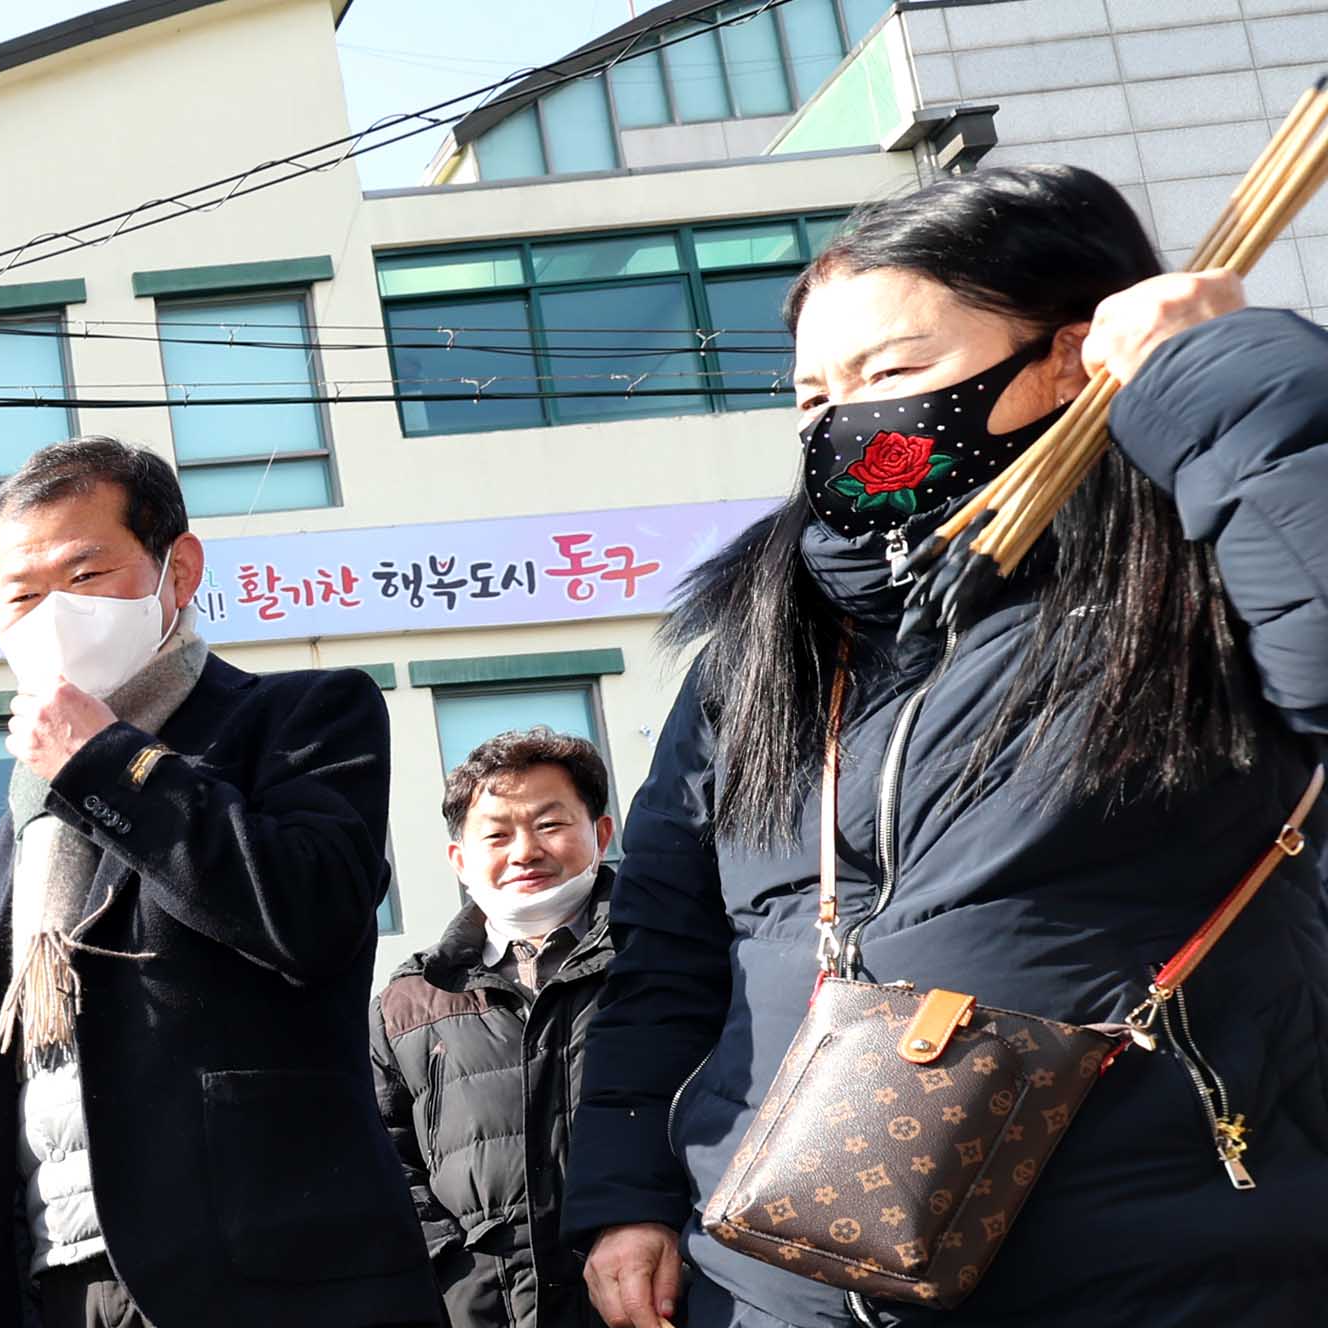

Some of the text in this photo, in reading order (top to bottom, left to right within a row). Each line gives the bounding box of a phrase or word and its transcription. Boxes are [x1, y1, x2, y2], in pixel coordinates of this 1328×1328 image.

[238, 565, 361, 620] 활기찬
[372, 555, 536, 610] 행복도시
[544, 533, 660, 600] 동구
